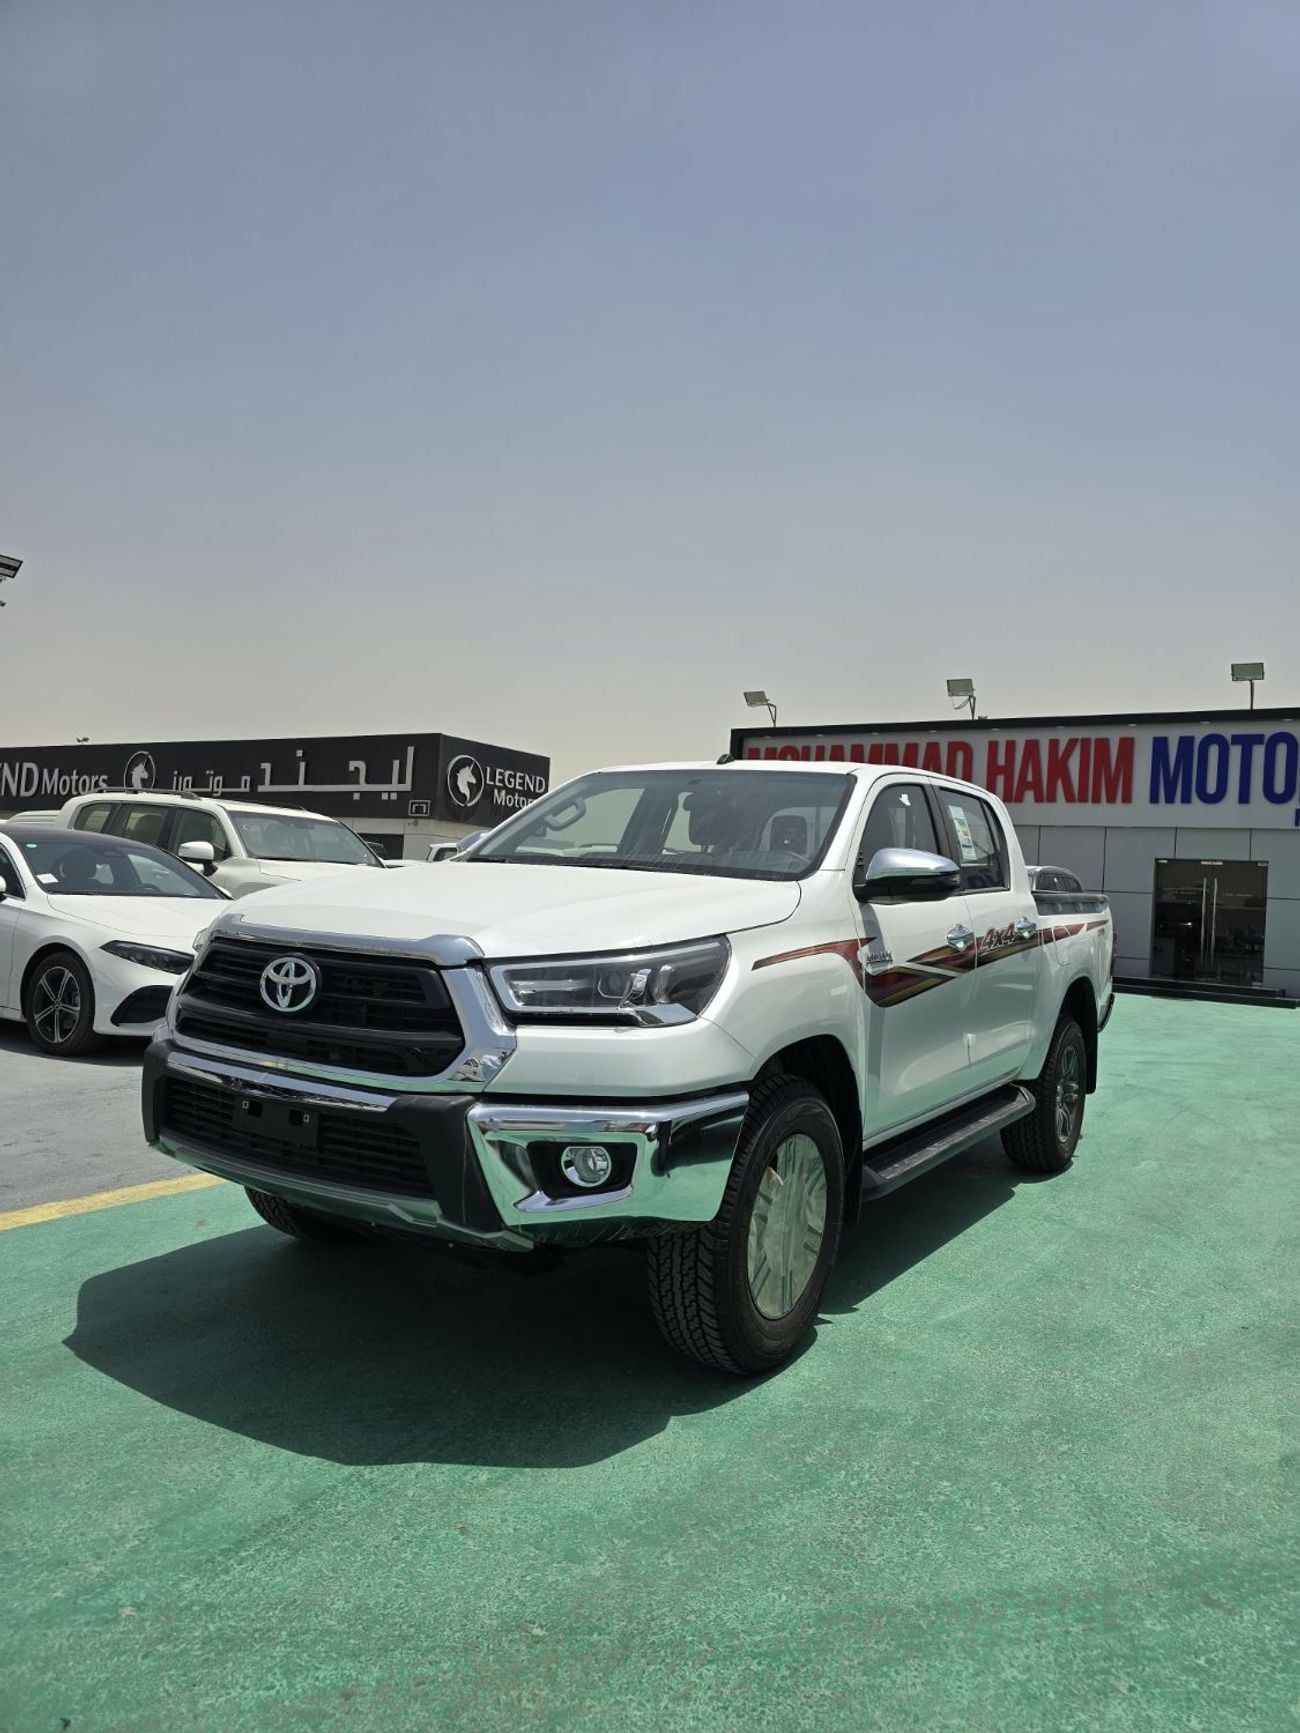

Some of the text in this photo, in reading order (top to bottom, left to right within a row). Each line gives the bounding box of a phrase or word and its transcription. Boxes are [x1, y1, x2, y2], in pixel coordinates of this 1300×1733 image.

[0, 762, 108, 797] ND Motors
[257, 746, 415, 801] ليجند
[486, 766, 546, 793] LEGEND
[986, 736, 1135, 803] HAKIM
[1150, 732, 1300, 805] MOTO
[494, 789, 537, 808] Motor
